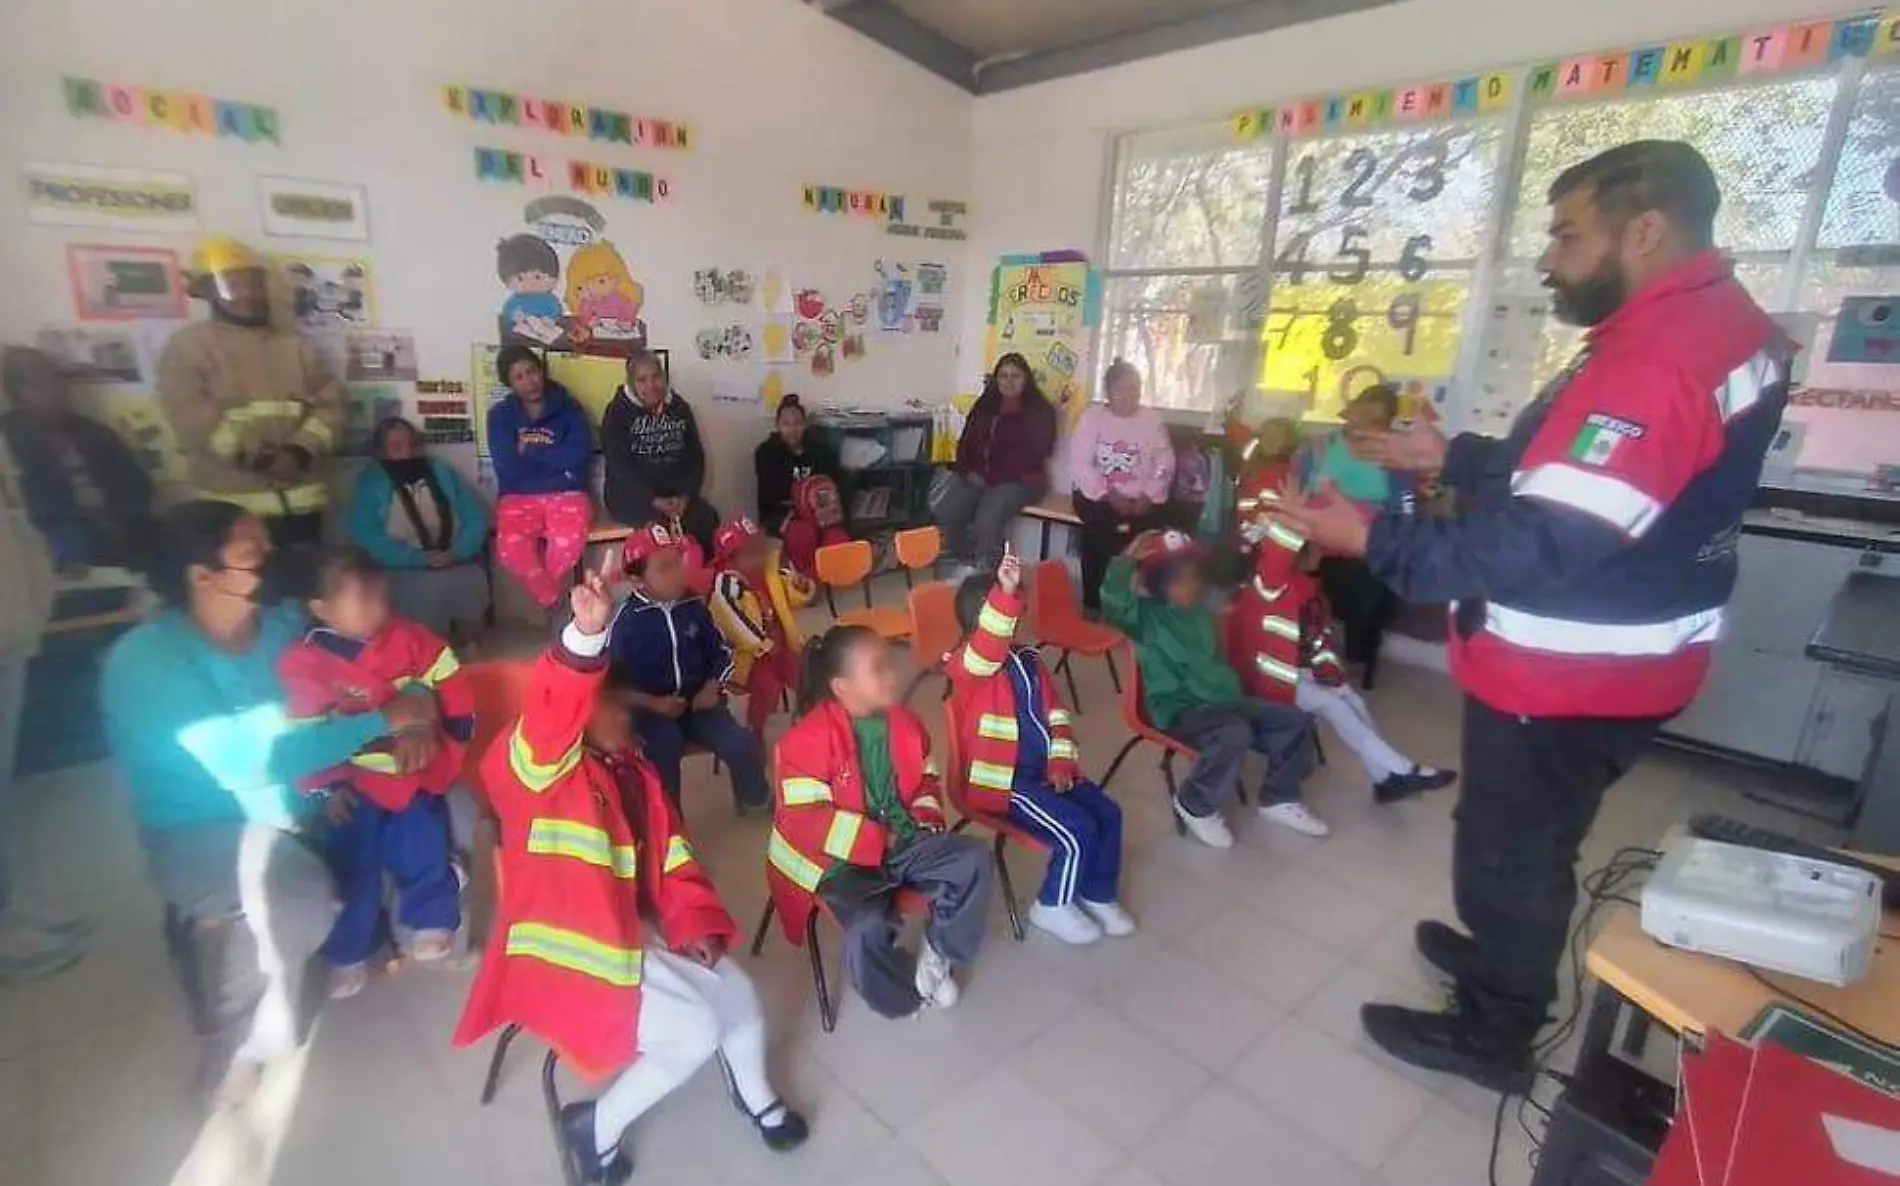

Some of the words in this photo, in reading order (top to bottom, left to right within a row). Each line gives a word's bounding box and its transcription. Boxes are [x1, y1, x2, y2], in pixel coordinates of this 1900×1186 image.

[1290, 154, 1318, 212] 1
[1339, 147, 1377, 206] 2
[1408, 135, 1445, 200] 3
[1275, 233, 1313, 285] 4
[1328, 225, 1370, 285] 5
[1400, 234, 1432, 282] 6
[1321, 298, 1357, 360] 8
[1388, 294, 1419, 356] 9
